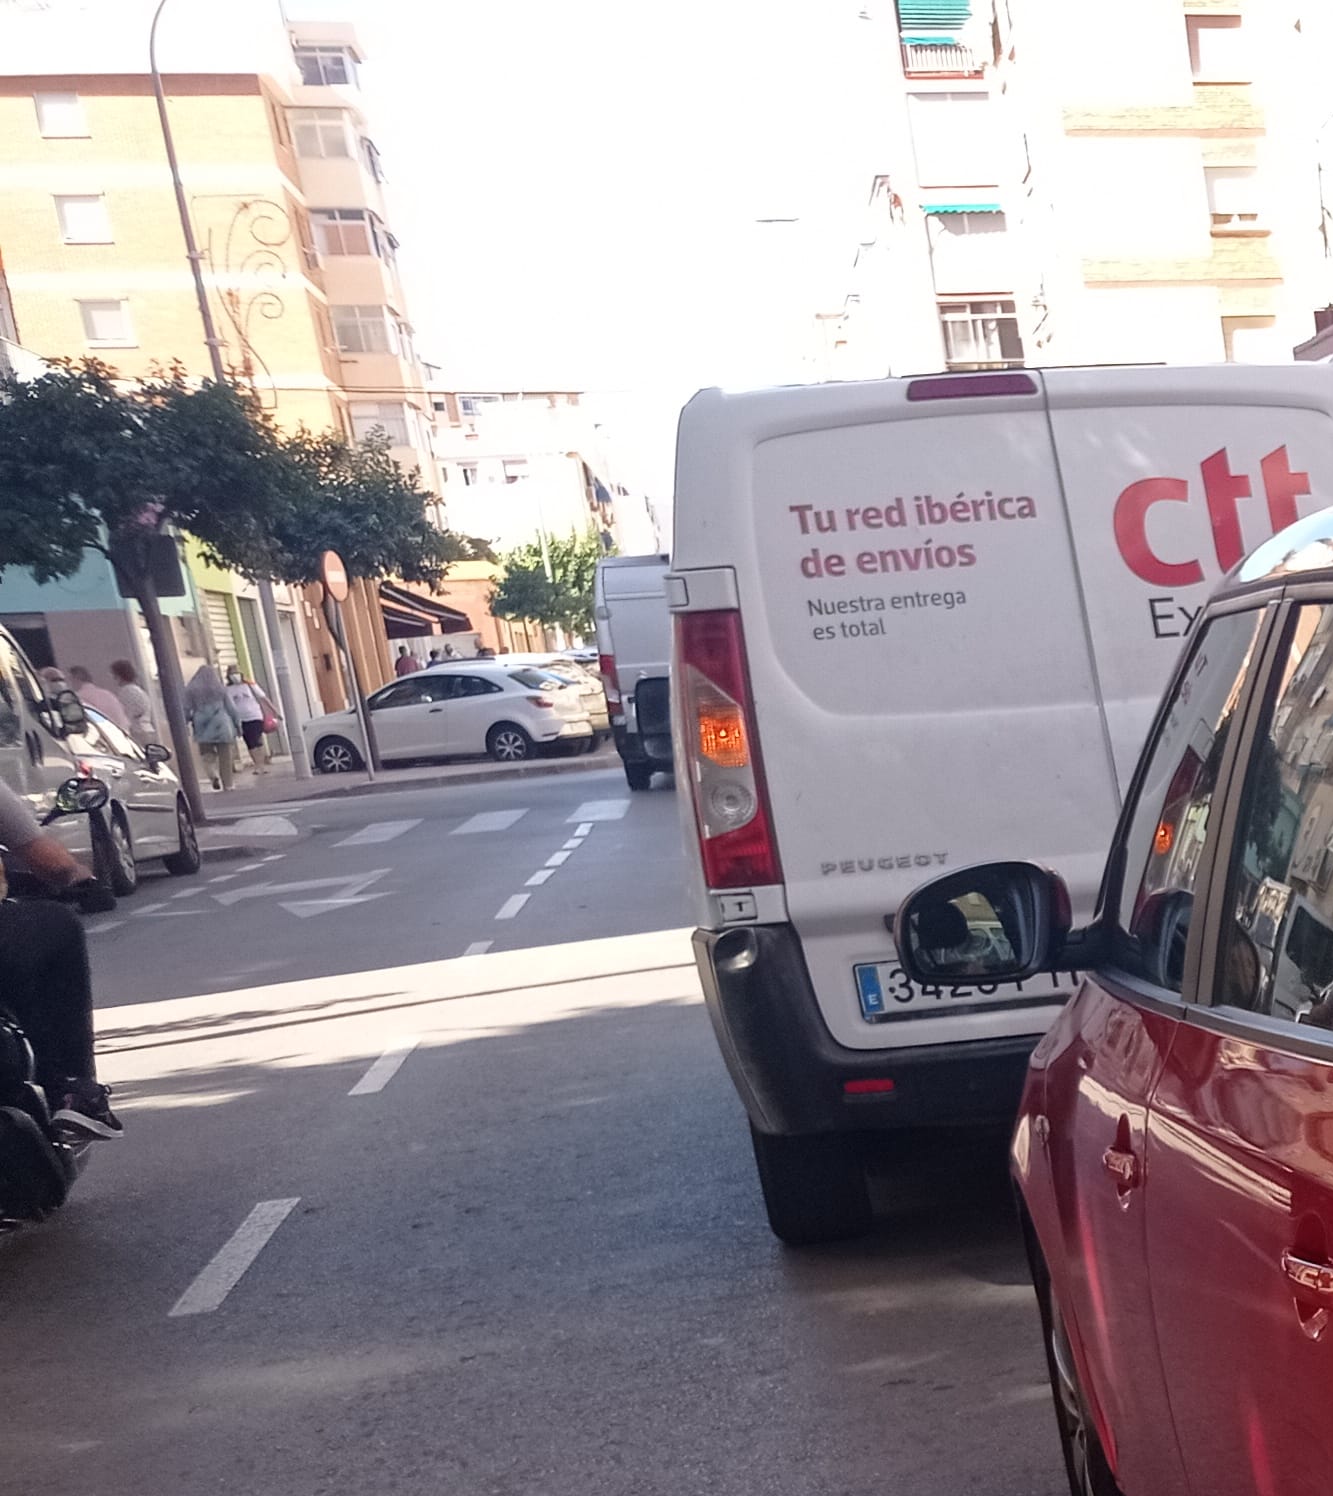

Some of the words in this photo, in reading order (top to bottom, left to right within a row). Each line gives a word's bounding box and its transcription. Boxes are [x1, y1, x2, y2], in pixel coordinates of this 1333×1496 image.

[789, 504, 837, 535] Tu
[846, 497, 907, 531] red
[914, 490, 1037, 526] ibérica
[1113, 444, 1312, 587] ctt
[800, 548, 846, 579] de
[856, 538, 977, 574] envíos
[807, 595, 886, 617] Nuestra
[891, 589, 967, 610] entrega
[812, 625, 836, 640] es
[841, 618, 886, 638] total
[820, 852, 949, 876] PEUGEOT
